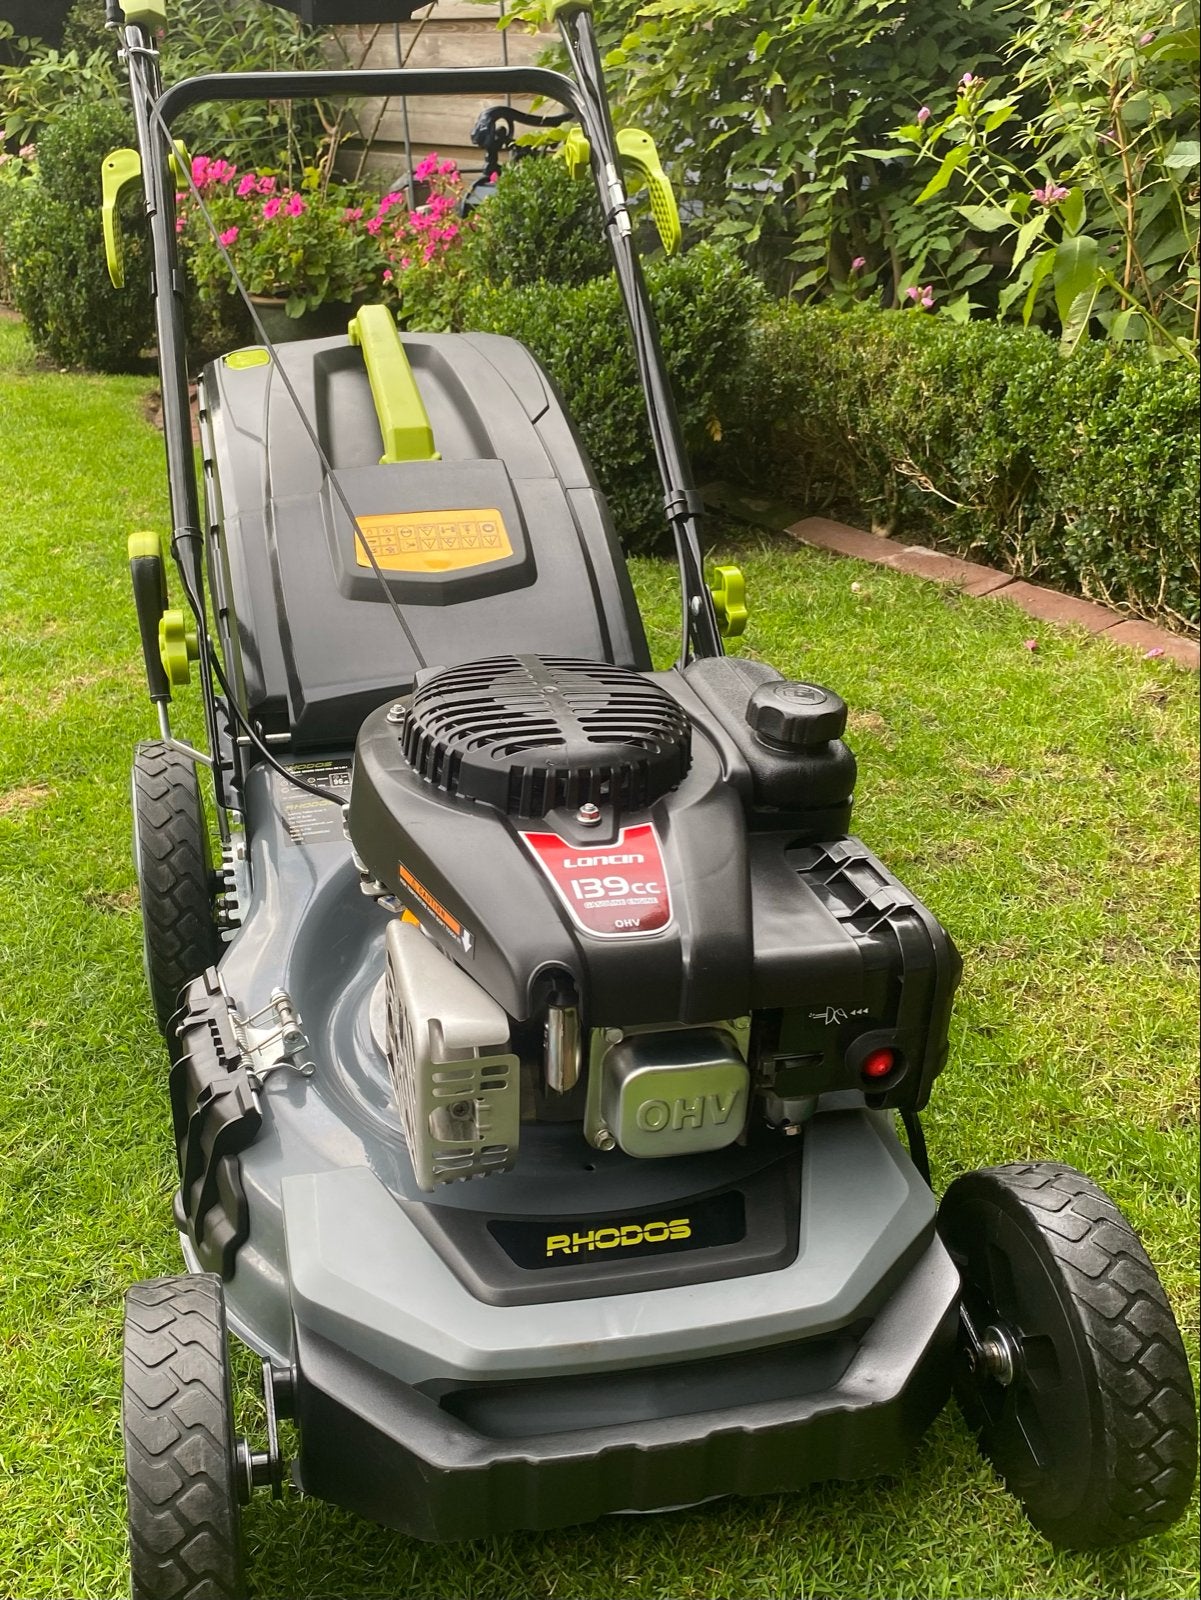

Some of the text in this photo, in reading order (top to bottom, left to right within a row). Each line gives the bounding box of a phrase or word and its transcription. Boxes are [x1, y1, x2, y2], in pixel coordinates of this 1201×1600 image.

[418, 886, 447, 919] CAUTION
[614, 918, 641, 928] OHV
[636, 1089, 740, 1133] OHV
[546, 1218, 692, 1257] RHODOS
